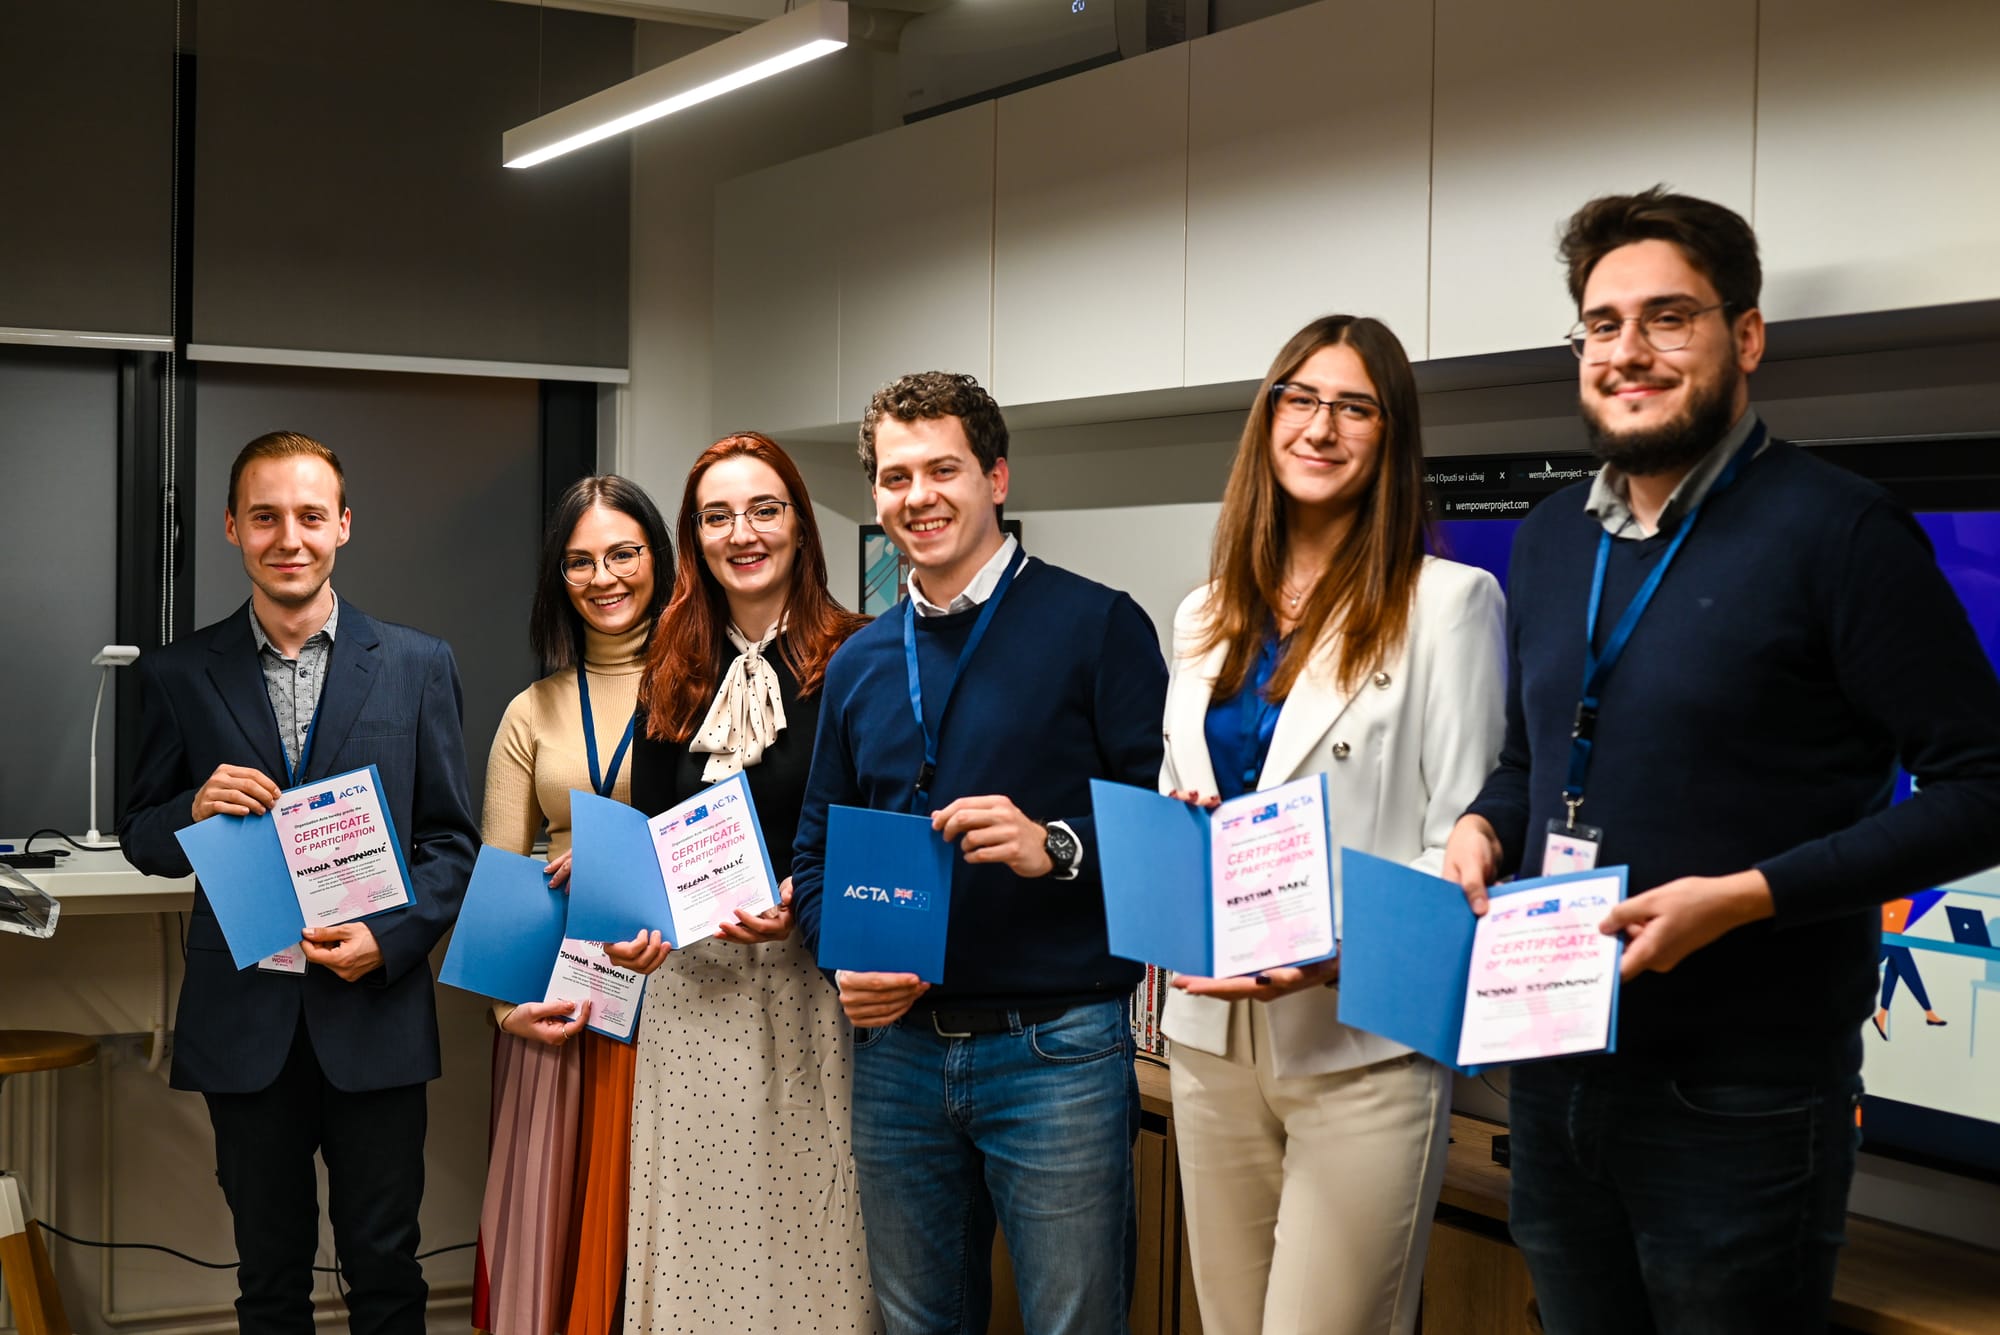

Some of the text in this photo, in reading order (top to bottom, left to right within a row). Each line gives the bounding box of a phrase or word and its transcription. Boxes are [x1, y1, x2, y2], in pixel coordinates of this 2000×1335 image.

[1439, 473, 1458, 484] Opusti
[1528, 469, 1582, 480] wempowerproject
[1456, 500, 1529, 512] wempowerproject.com
[339, 784, 368, 800] ACTA
[712, 794, 738, 812] ACTA
[294, 813, 371, 843] CERTIFICATE
[295, 825, 375, 856] OF PARTICIPATION
[672, 821, 741, 861] CERTIFICATE
[1227, 832, 1311, 866] CERTIFICATE
[672, 833, 745, 873] OF PARTICIPATION
[296, 863, 331, 877] NIKOLA
[677, 874, 709, 892] JELENA
[843, 884, 890, 903] ACTA
[1491, 934, 1598, 955] CERTIFICATE
[560, 950, 589, 967] JOVANA
[593, 962, 637, 984] JANKOVIĆ
